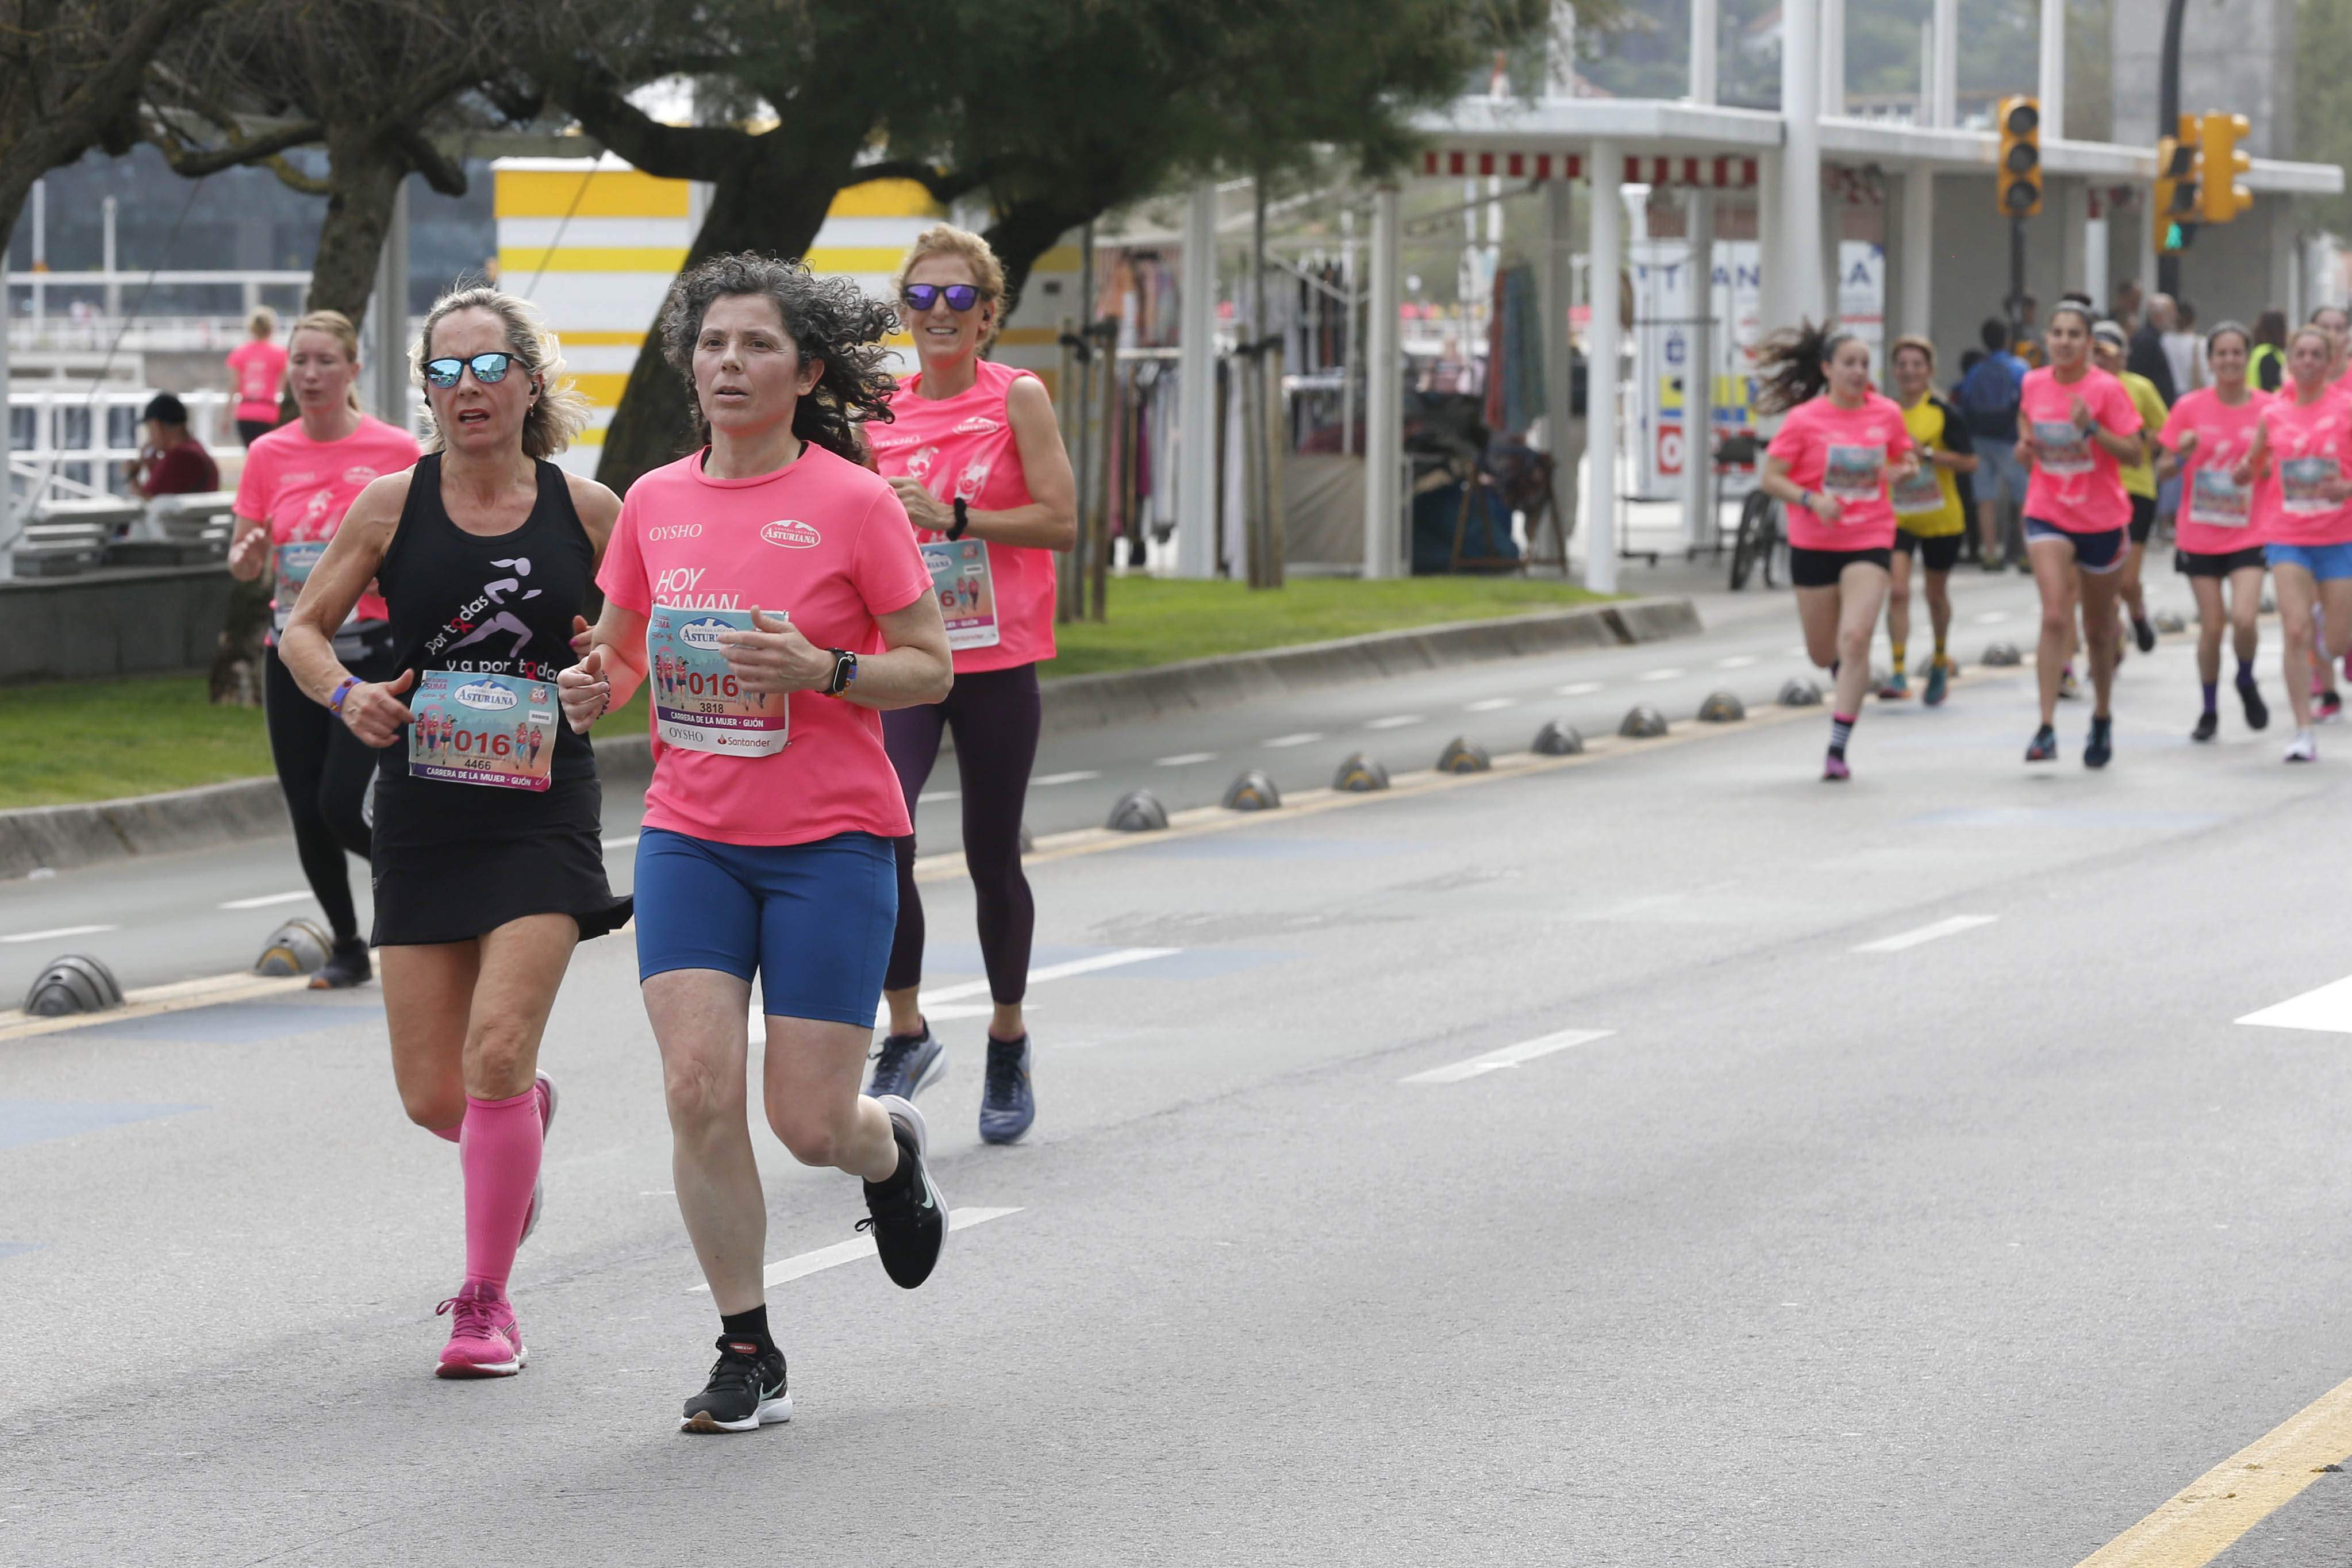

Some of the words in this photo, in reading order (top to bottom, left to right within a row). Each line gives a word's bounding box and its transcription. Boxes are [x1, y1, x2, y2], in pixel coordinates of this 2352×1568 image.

[650, 524, 702, 541] OYSHO
[764, 527, 815, 544] ASTURIANA
[655, 568, 706, 593] HOY
[425, 633, 448, 655] Por
[683, 629, 718, 642] ASTURI
[479, 660, 510, 672] por
[519, 659, 558, 681] toda
[690, 672, 739, 697] 016
[458, 689, 514, 706] ASTURIANA
[700, 702, 724, 714] 3818
[671, 712, 695, 722] CARRERA
[696, 715, 704, 724] DE
[705, 716, 714, 724] LA
[716, 717, 737, 726] MUJER
[743, 717, 764, 728] GIJÓN
[454, 730, 510, 755] 016
[669, 727, 704, 742] OYSHO
[728, 736, 771, 747] Santander
[464, 759, 491, 770] 4466
[426, 767, 456, 778] CARRERA
[458, 770, 467, 779] DE
[468, 771, 478, 780] LA
[479, 773, 505, 783] MUJER
[511, 776, 531, 786] GIJÓN
